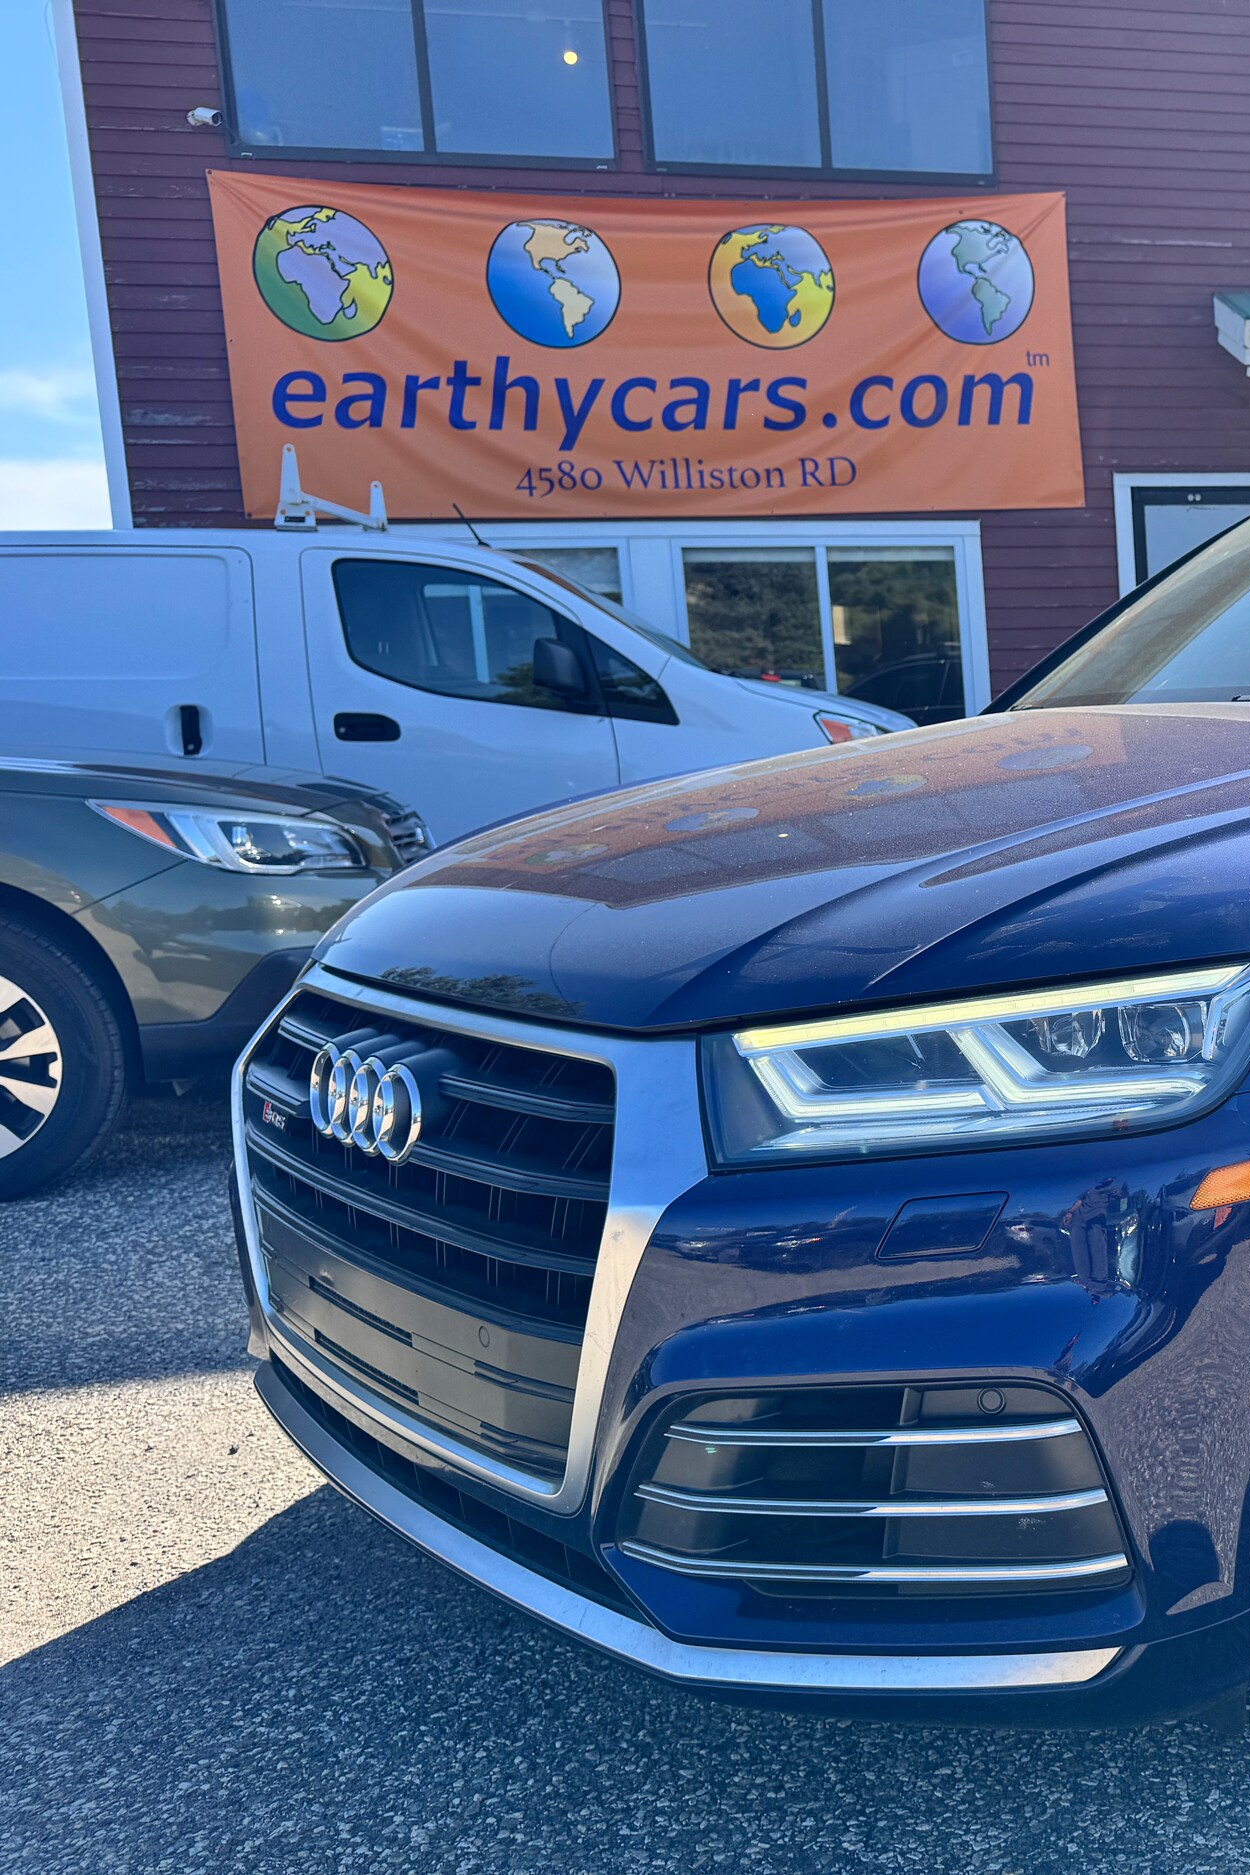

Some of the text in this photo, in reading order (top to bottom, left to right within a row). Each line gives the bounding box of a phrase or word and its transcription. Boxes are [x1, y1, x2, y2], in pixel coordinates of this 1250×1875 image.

[271, 356, 1034, 452] earthycars.com
[515, 455, 858, 497] 4580 Williston RD
